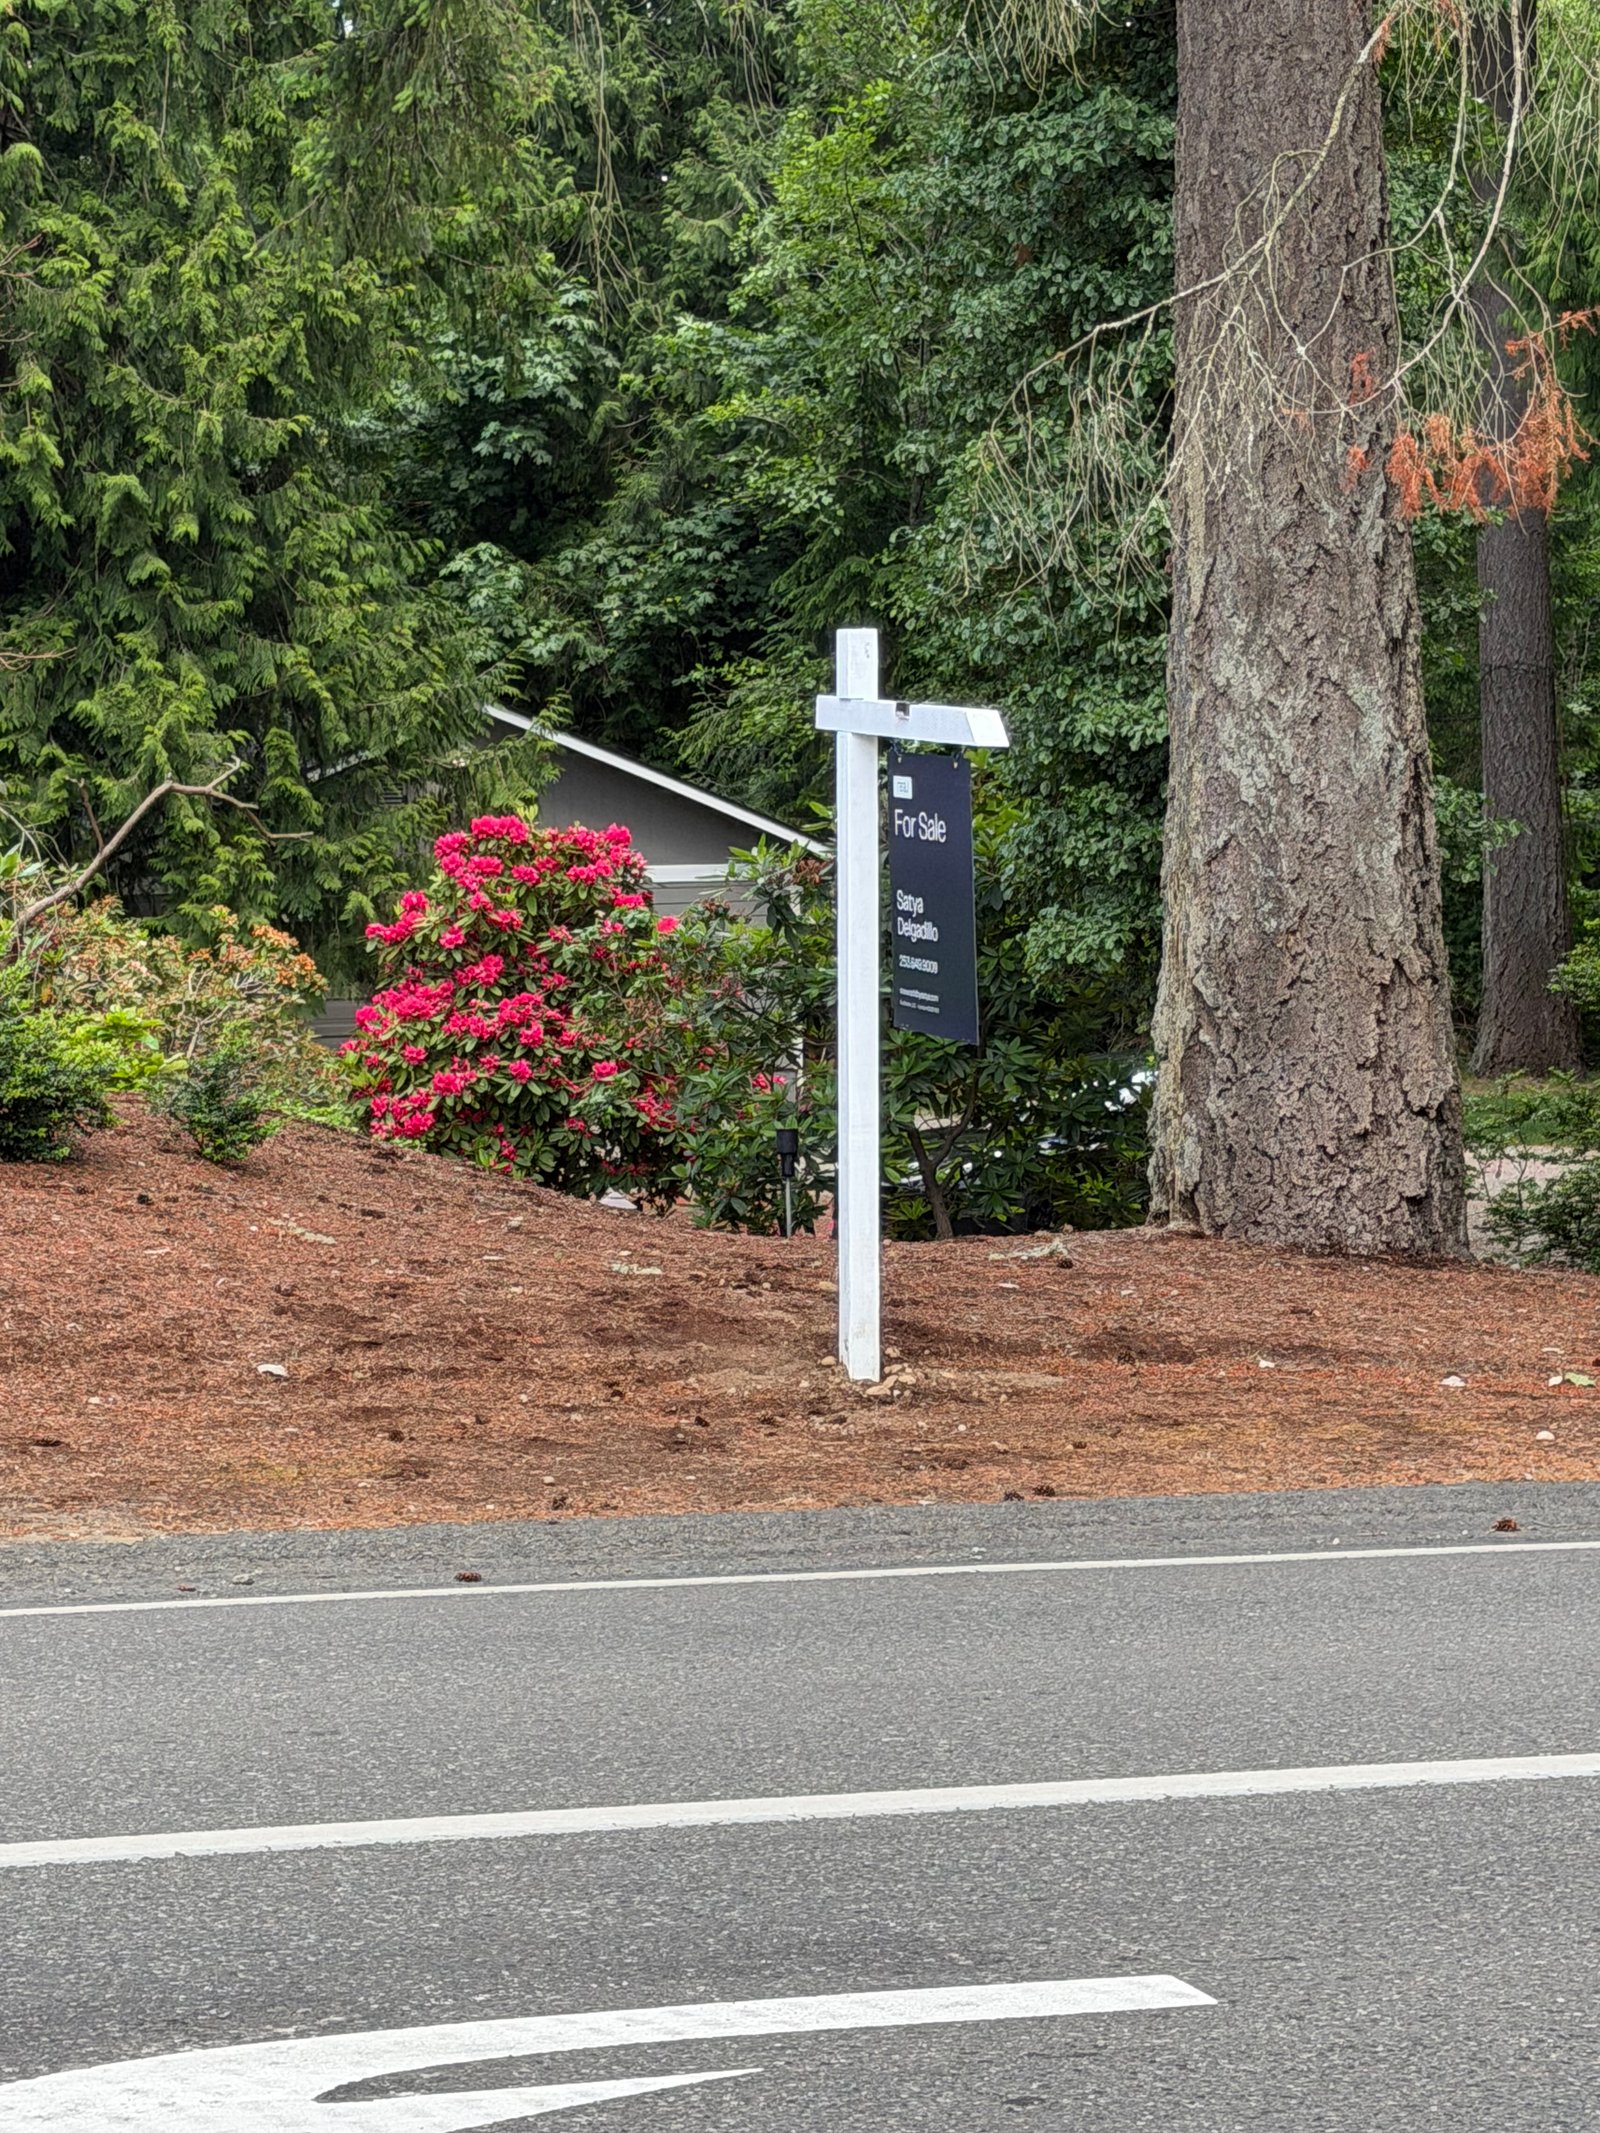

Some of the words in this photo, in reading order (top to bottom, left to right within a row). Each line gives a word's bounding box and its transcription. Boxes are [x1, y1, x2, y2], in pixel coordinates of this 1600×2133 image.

[894, 808, 916, 838] For
[918, 811, 947, 843] Sale
[896, 889, 924, 918] Satya
[897, 916, 939, 943] Delgadillo
